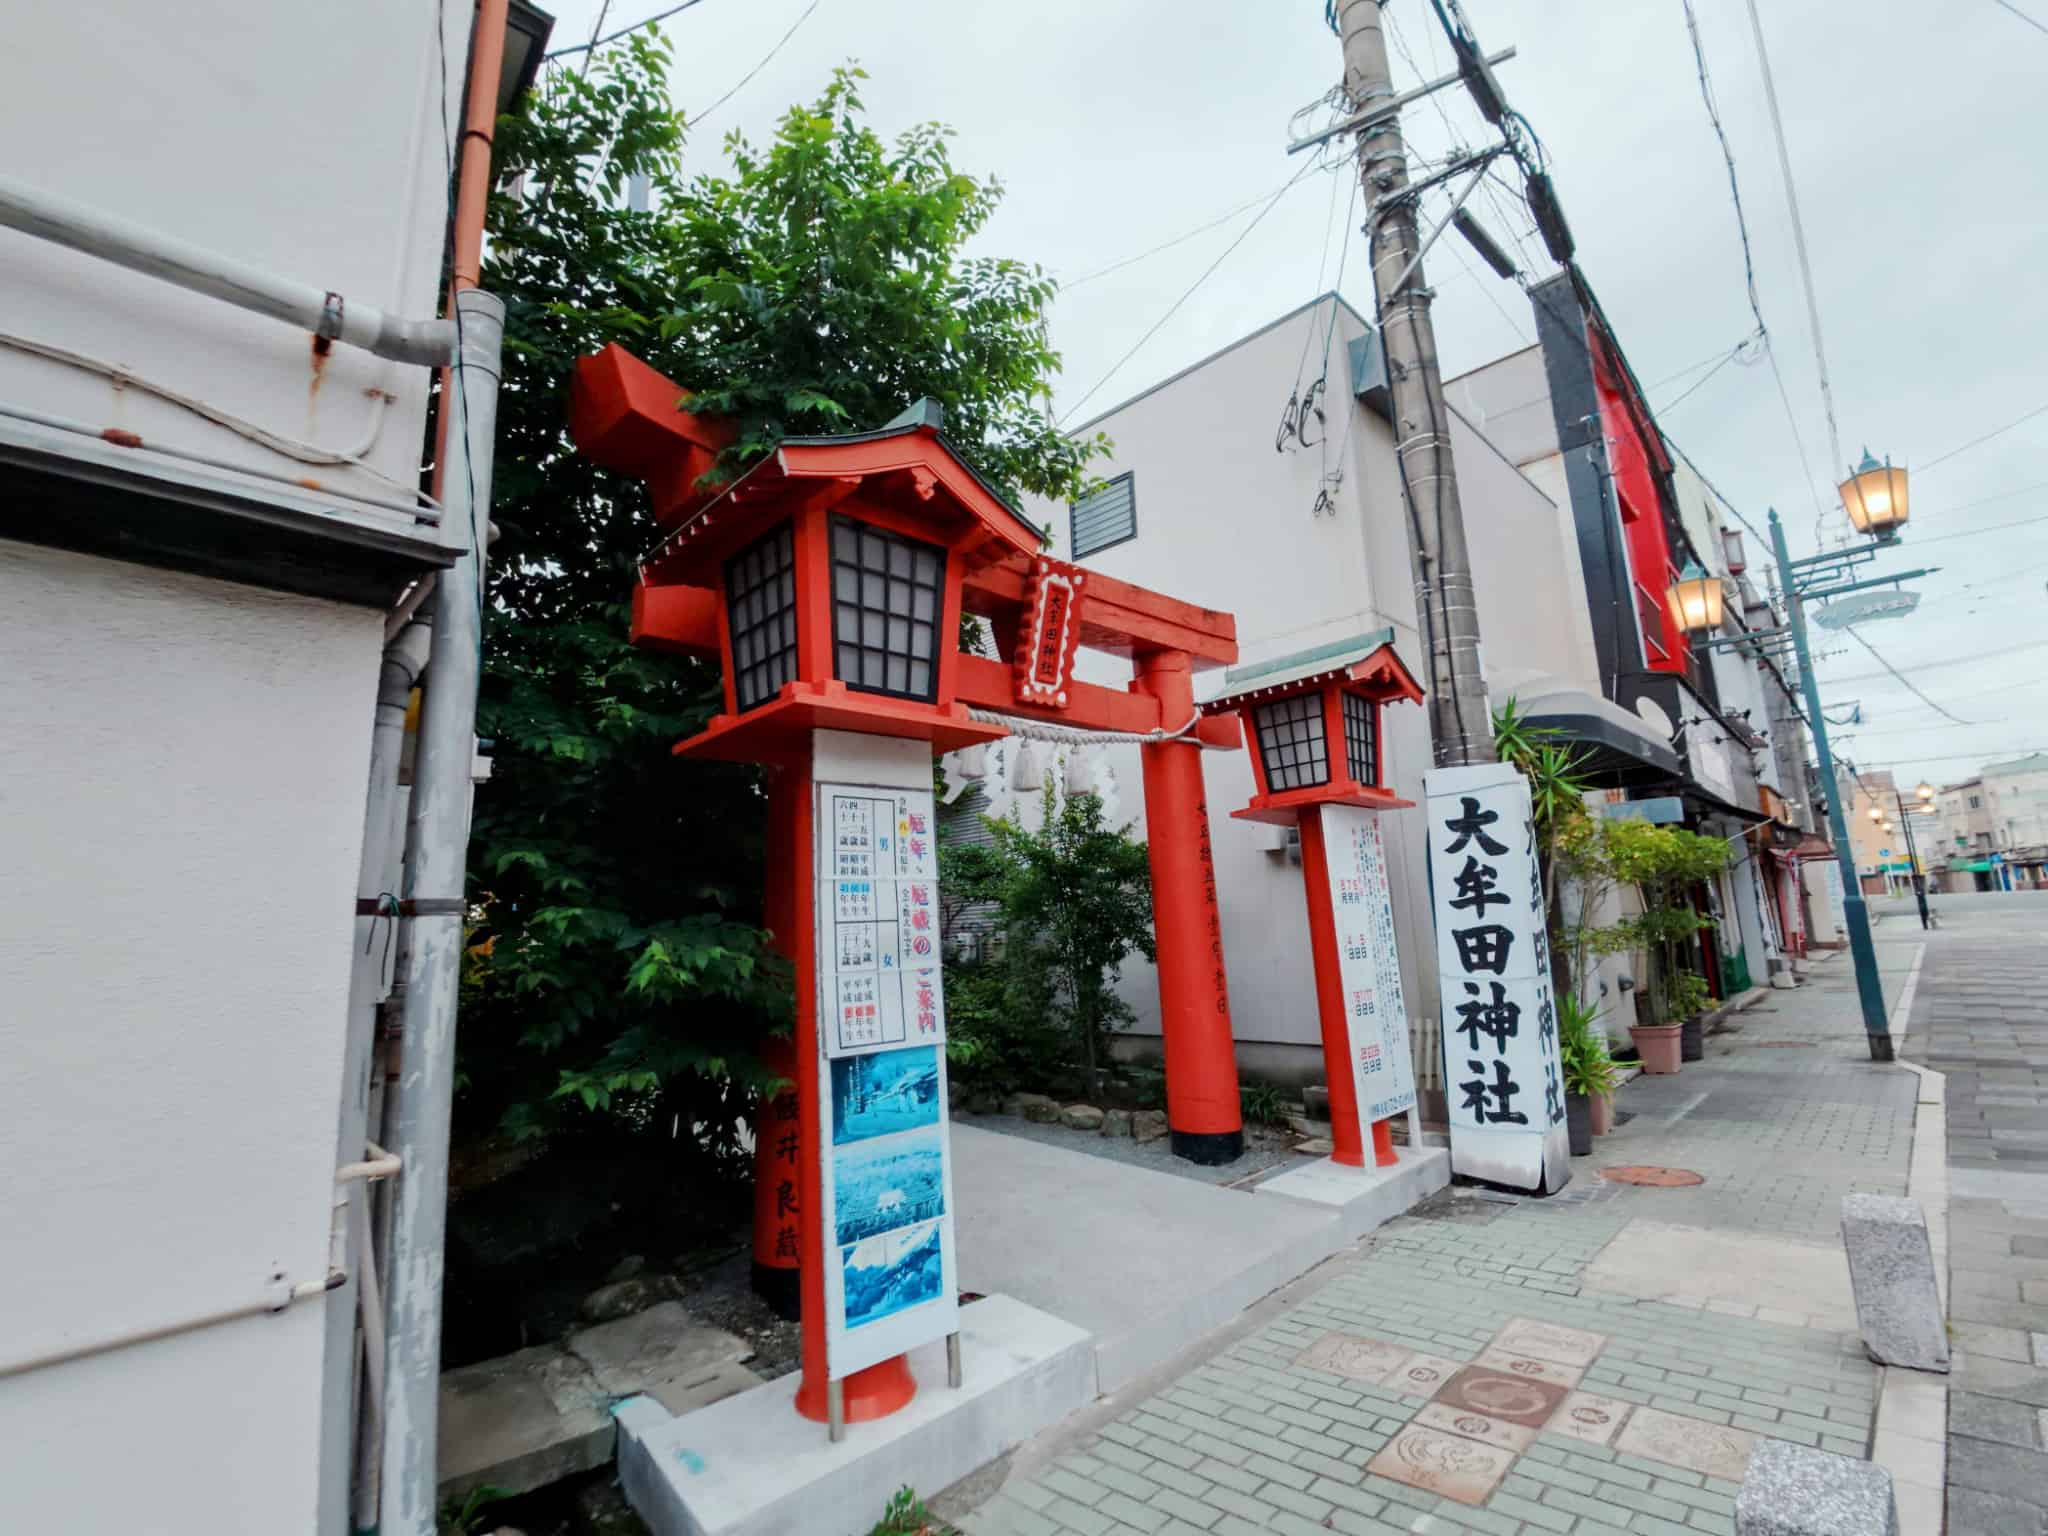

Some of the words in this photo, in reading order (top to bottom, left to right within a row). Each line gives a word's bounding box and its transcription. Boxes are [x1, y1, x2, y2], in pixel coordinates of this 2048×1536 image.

[879, 837, 889, 852] 男
[883, 953, 893, 968] 女
[1444, 796, 1529, 1126] 大牟田神社
[1524, 797, 1567, 1128] 大牟田神社
